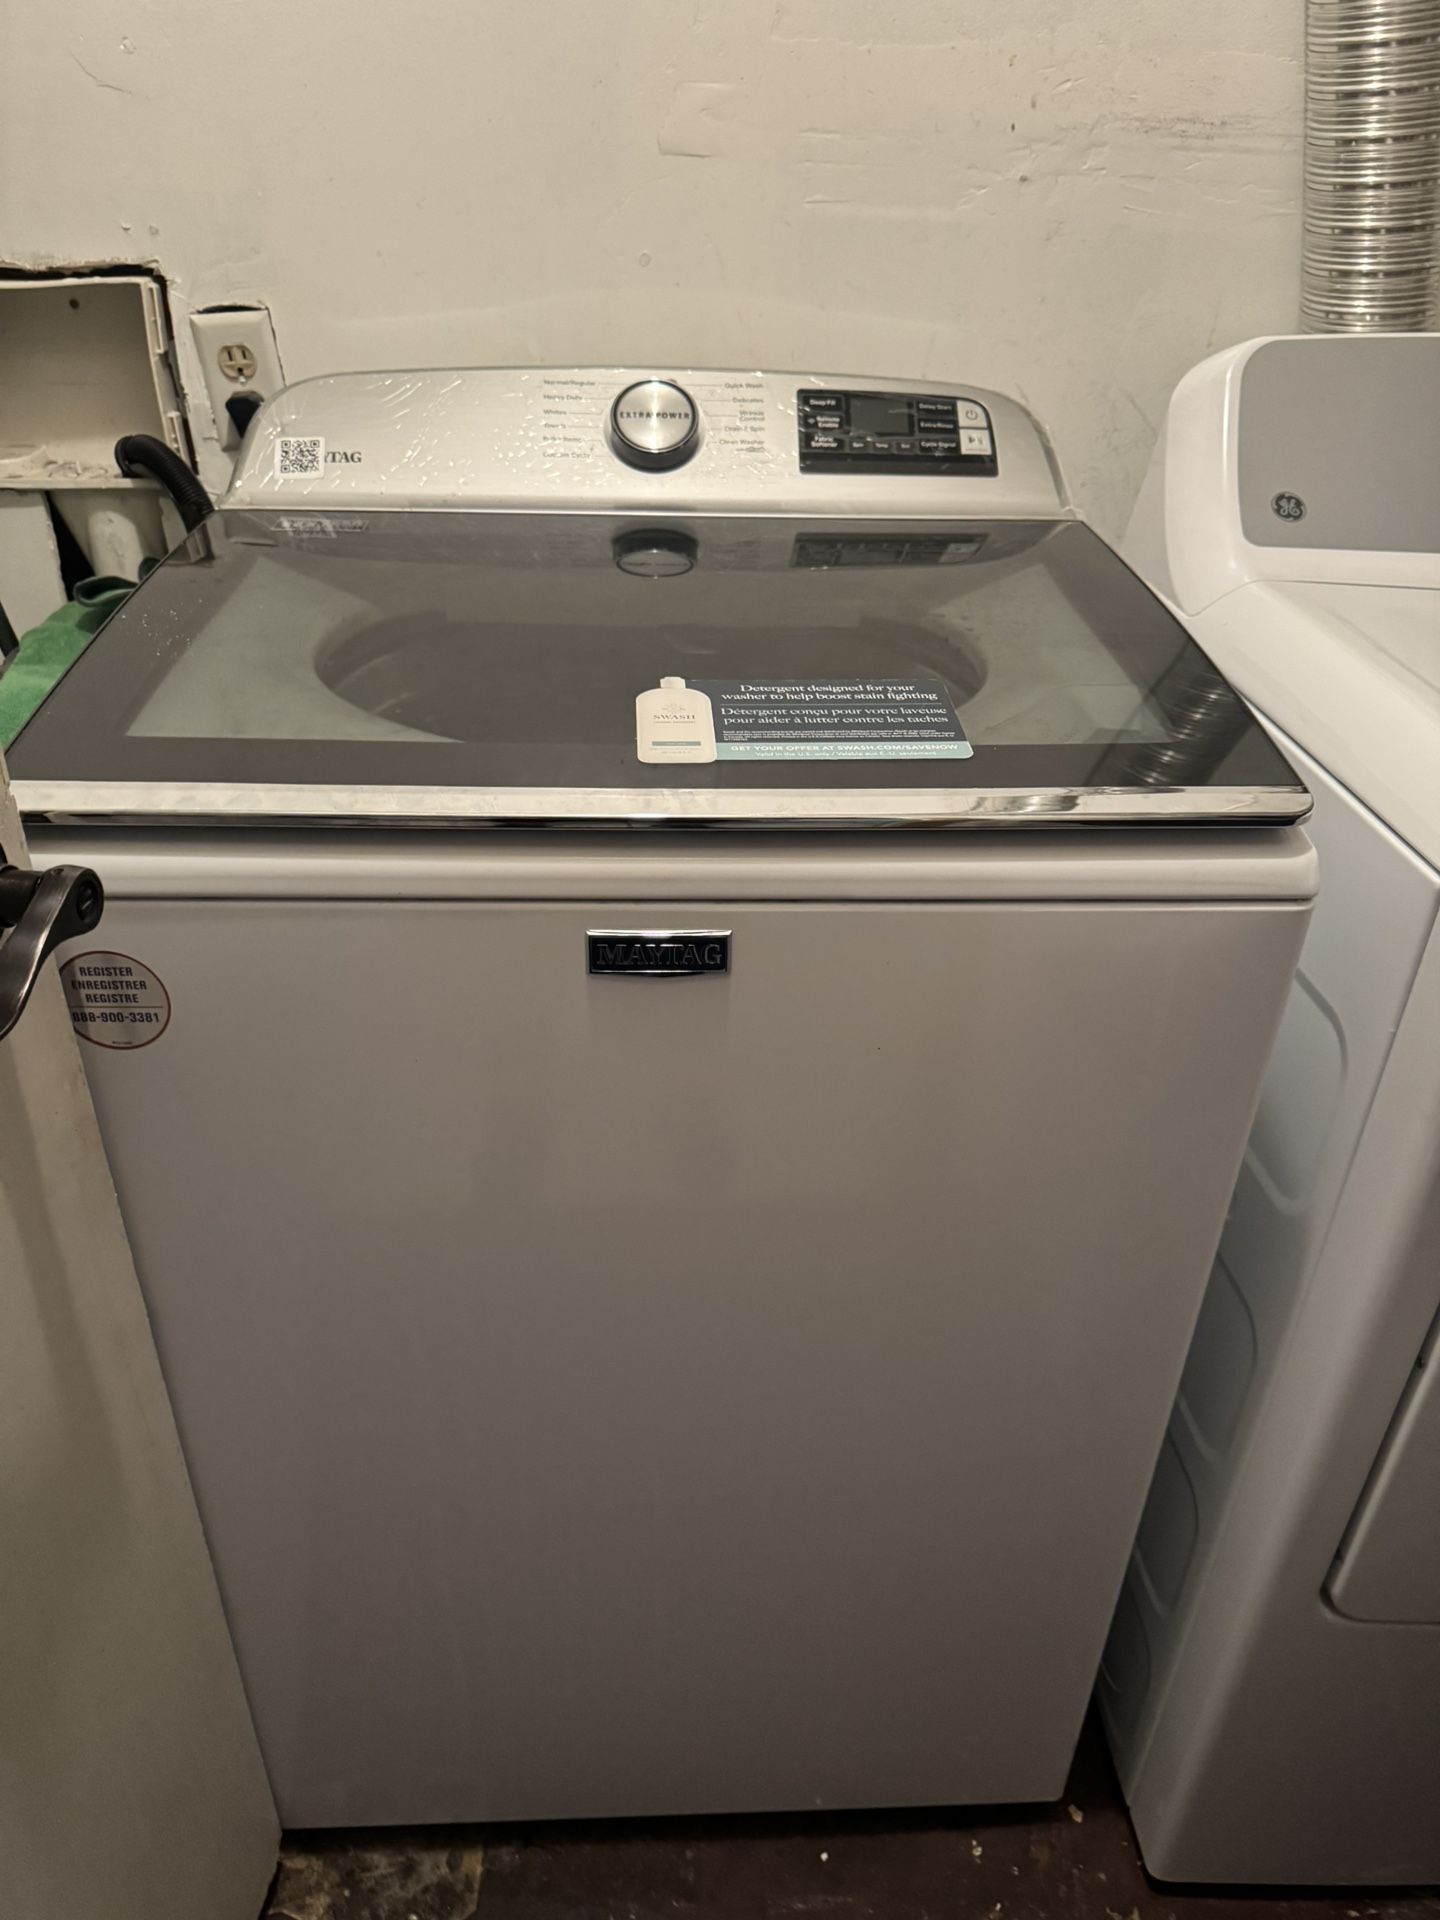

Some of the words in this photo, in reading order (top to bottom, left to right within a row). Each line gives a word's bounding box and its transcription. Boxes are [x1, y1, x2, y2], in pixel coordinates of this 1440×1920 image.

[620, 411, 653, 419] EXTRA
[655, 411, 690, 420] POWER
[324, 451, 362, 463] TAG
[740, 684, 805, 693] Detergent
[807, 684, 863, 693] designed
[866, 684, 884, 692] for
[887, 685, 915, 693] your
[786, 693, 814, 701] help
[854, 692, 885, 700] stain
[887, 692, 938, 701] fighting
[721, 707, 787, 716] Détergent
[789, 709, 829, 717] conçu
[831, 708, 862, 716] pour
[900, 707, 947, 715] laveuse
[724, 717, 755, 726] pour
[758, 716, 792, 724] aider
[794, 716, 802, 724] à
[804, 716, 840, 724] lutter
[886, 715, 905, 723] les
[596, 943, 723, 965] MAYTAG
[79, 966, 133, 977] REGISTER
[71, 980, 148, 990] ENREGISTRER
[85, 993, 140, 1004] REGISTRE
